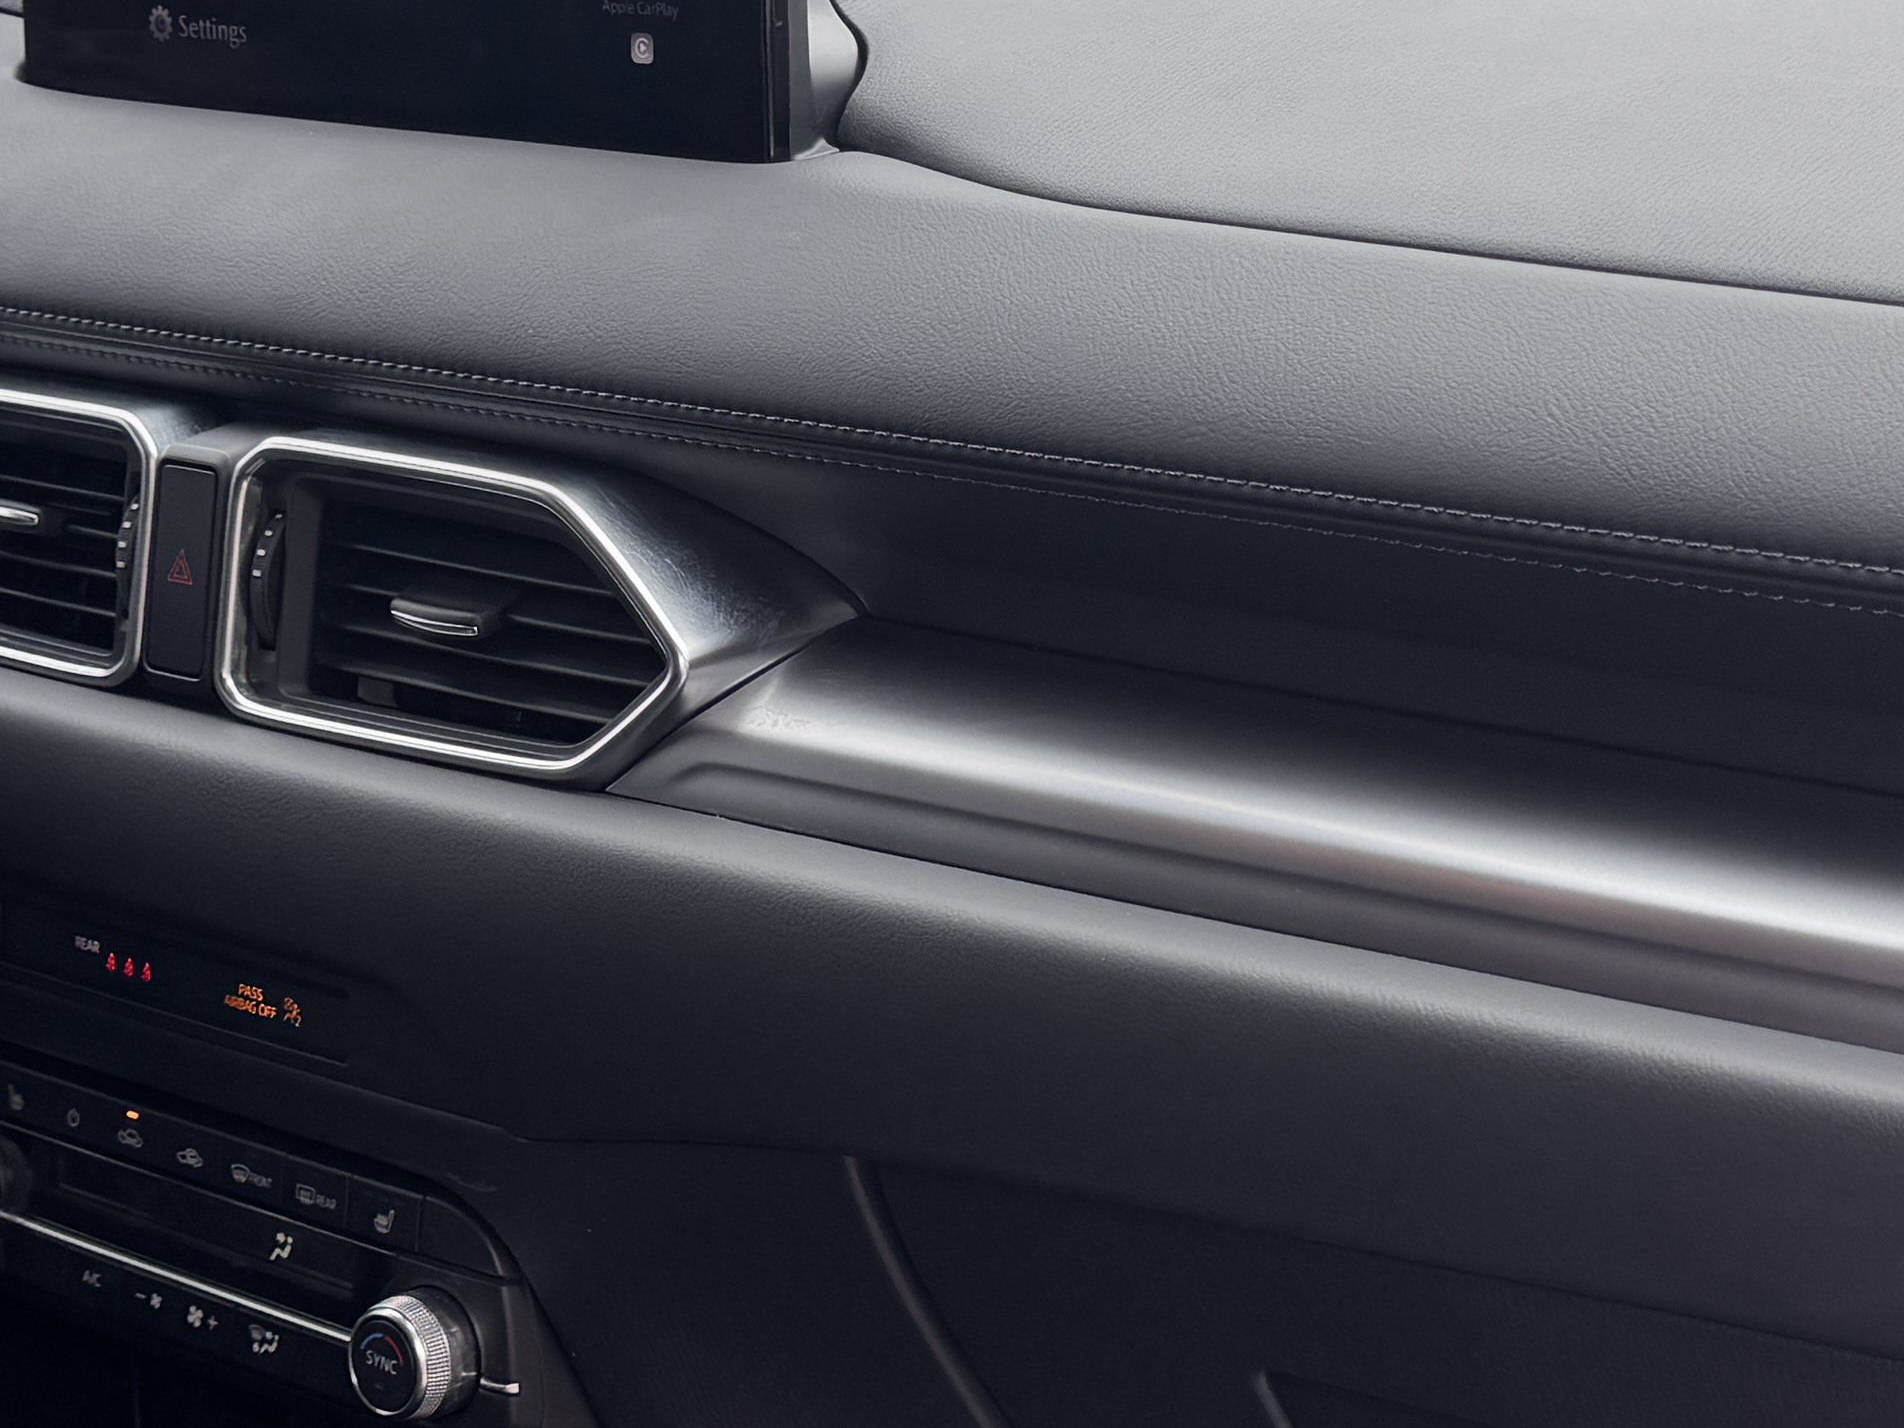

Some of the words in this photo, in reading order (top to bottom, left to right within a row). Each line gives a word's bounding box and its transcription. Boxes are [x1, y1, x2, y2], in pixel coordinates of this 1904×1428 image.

[602, 0, 634, 16] Apple
[636, 0, 679, 21] CarPlay
[178, 15, 247, 49] Settings
[75, 936, 101, 954] REAR
[238, 983, 264, 1002] PASS
[224, 994, 257, 1015] AIRBAG
[258, 1002, 278, 1020] OFF
[366, 1350, 398, 1376] SYNC
